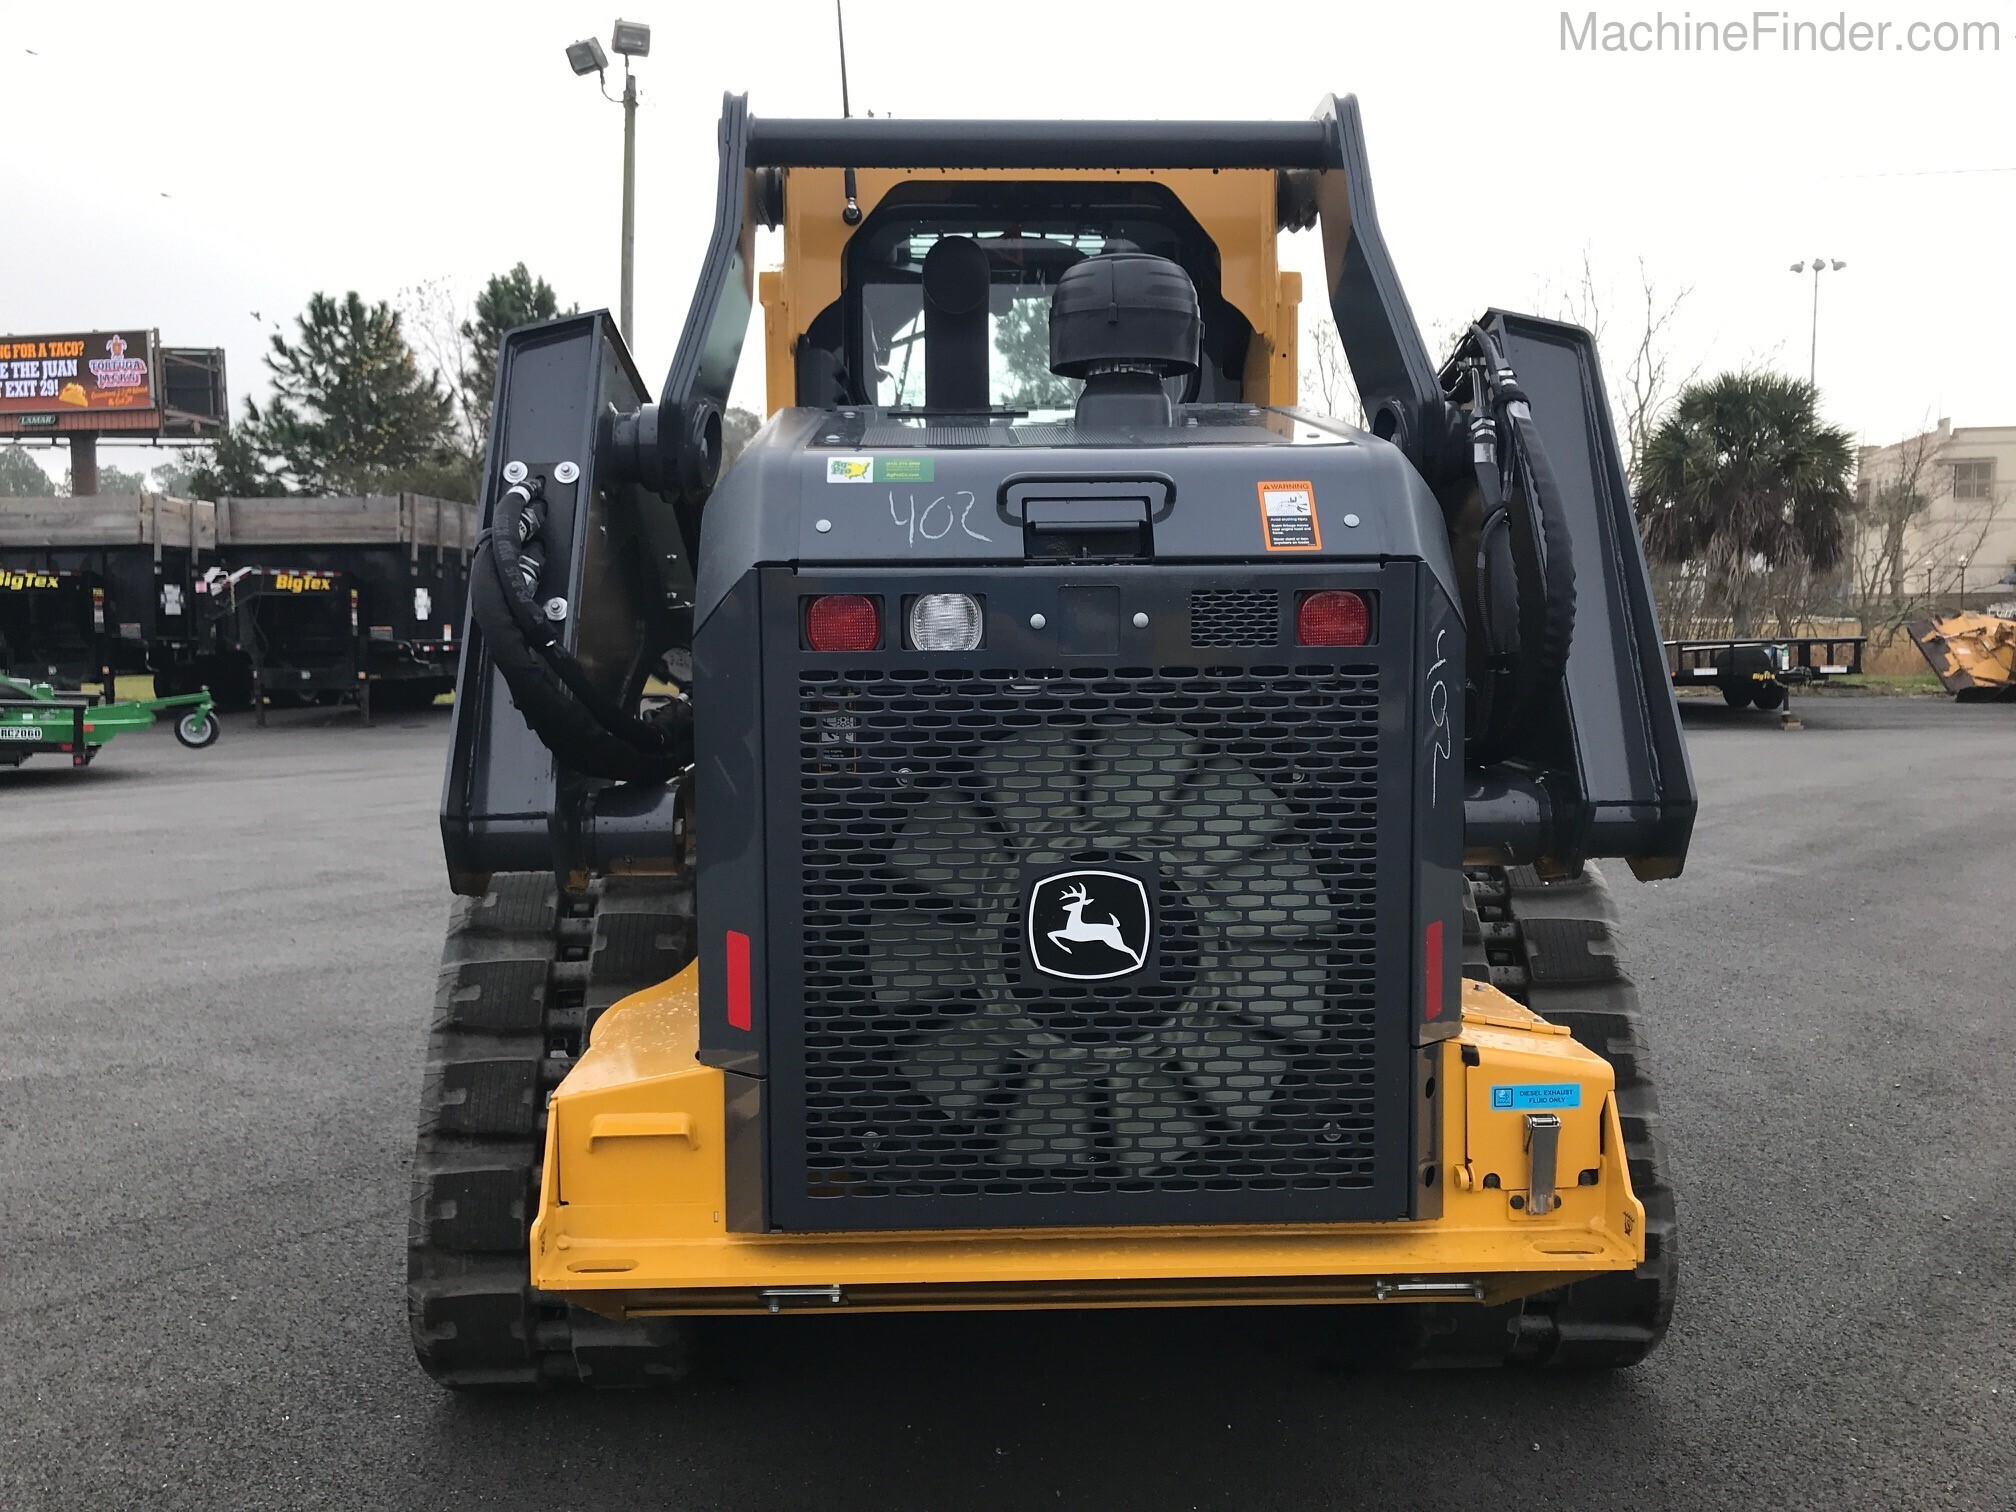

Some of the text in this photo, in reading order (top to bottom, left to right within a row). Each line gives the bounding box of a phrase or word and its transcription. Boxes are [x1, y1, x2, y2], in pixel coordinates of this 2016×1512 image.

[13, 343, 37, 359] FOR
[38, 342, 48, 358] A
[49, 340, 85, 357] TACO?
[11, 360, 40, 379] THE
[42, 359, 78, 380] JUAN
[5, 380, 38, 398] EXIT
[40, 379, 59, 397] 29!
[21, 415, 53, 425] LAMAR
[888, 490, 994, 549] 402
[0, 571, 59, 591] igTex
[276, 573, 331, 593] BigTex
[0, 727, 42, 740] RC2060
